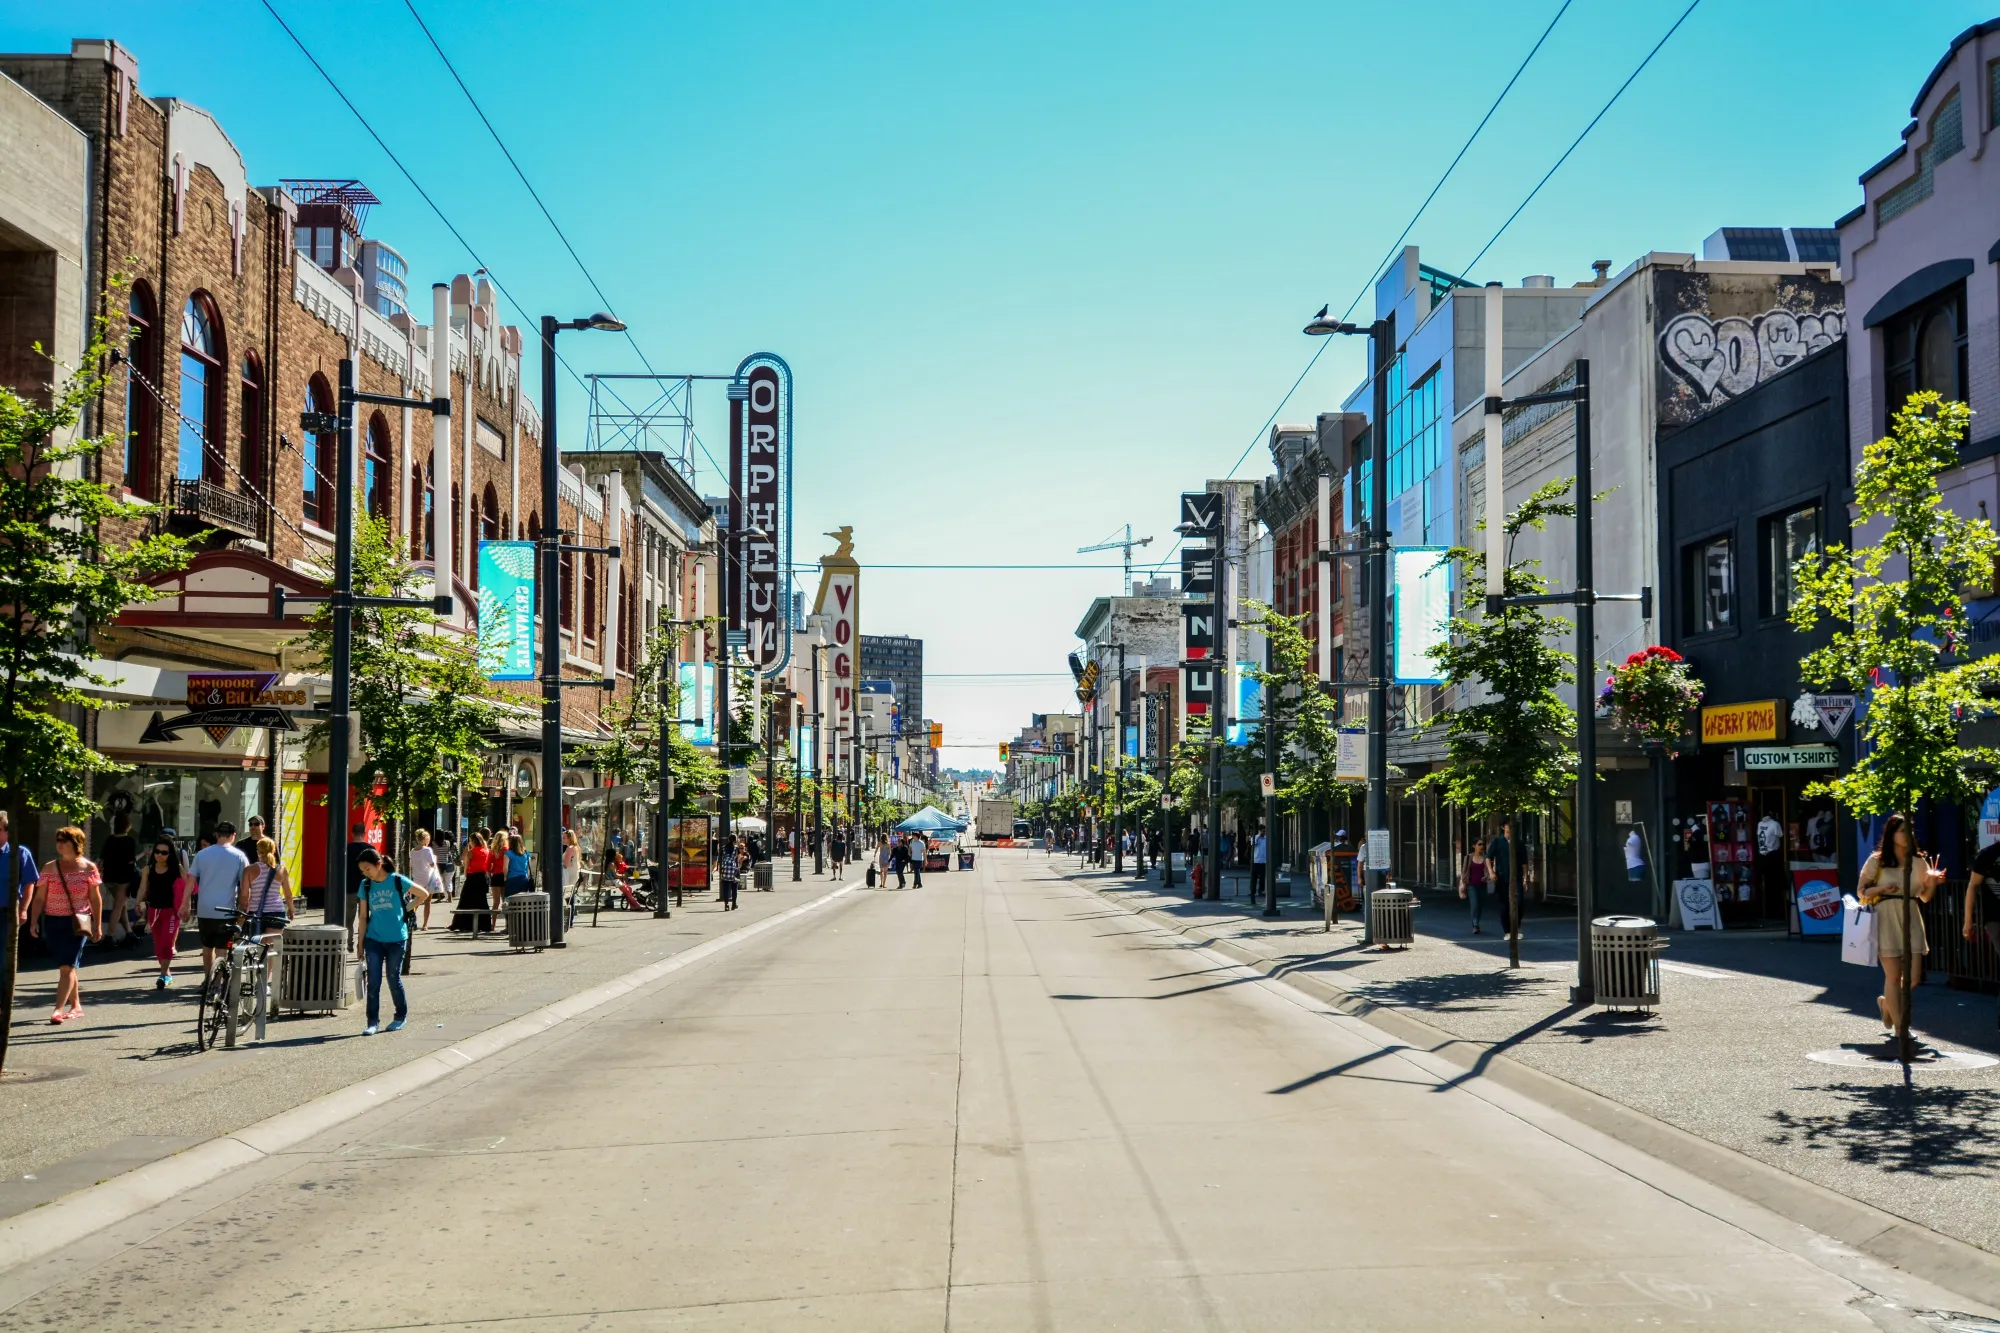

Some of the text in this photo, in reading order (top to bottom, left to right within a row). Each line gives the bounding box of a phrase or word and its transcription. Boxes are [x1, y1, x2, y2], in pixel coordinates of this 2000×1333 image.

[748, 379, 775, 652] ORPHEUM
[882, 637, 918, 647] GRANVILLE
[835, 585, 851, 742] VOGUE
[187, 679, 256, 688] OMMODORE
[1704, 709, 1774, 736] CHERRY BOMB
[1746, 751, 1839, 765] CUSTOM T-SHIRTS
[368, 828, 382, 844] sale
